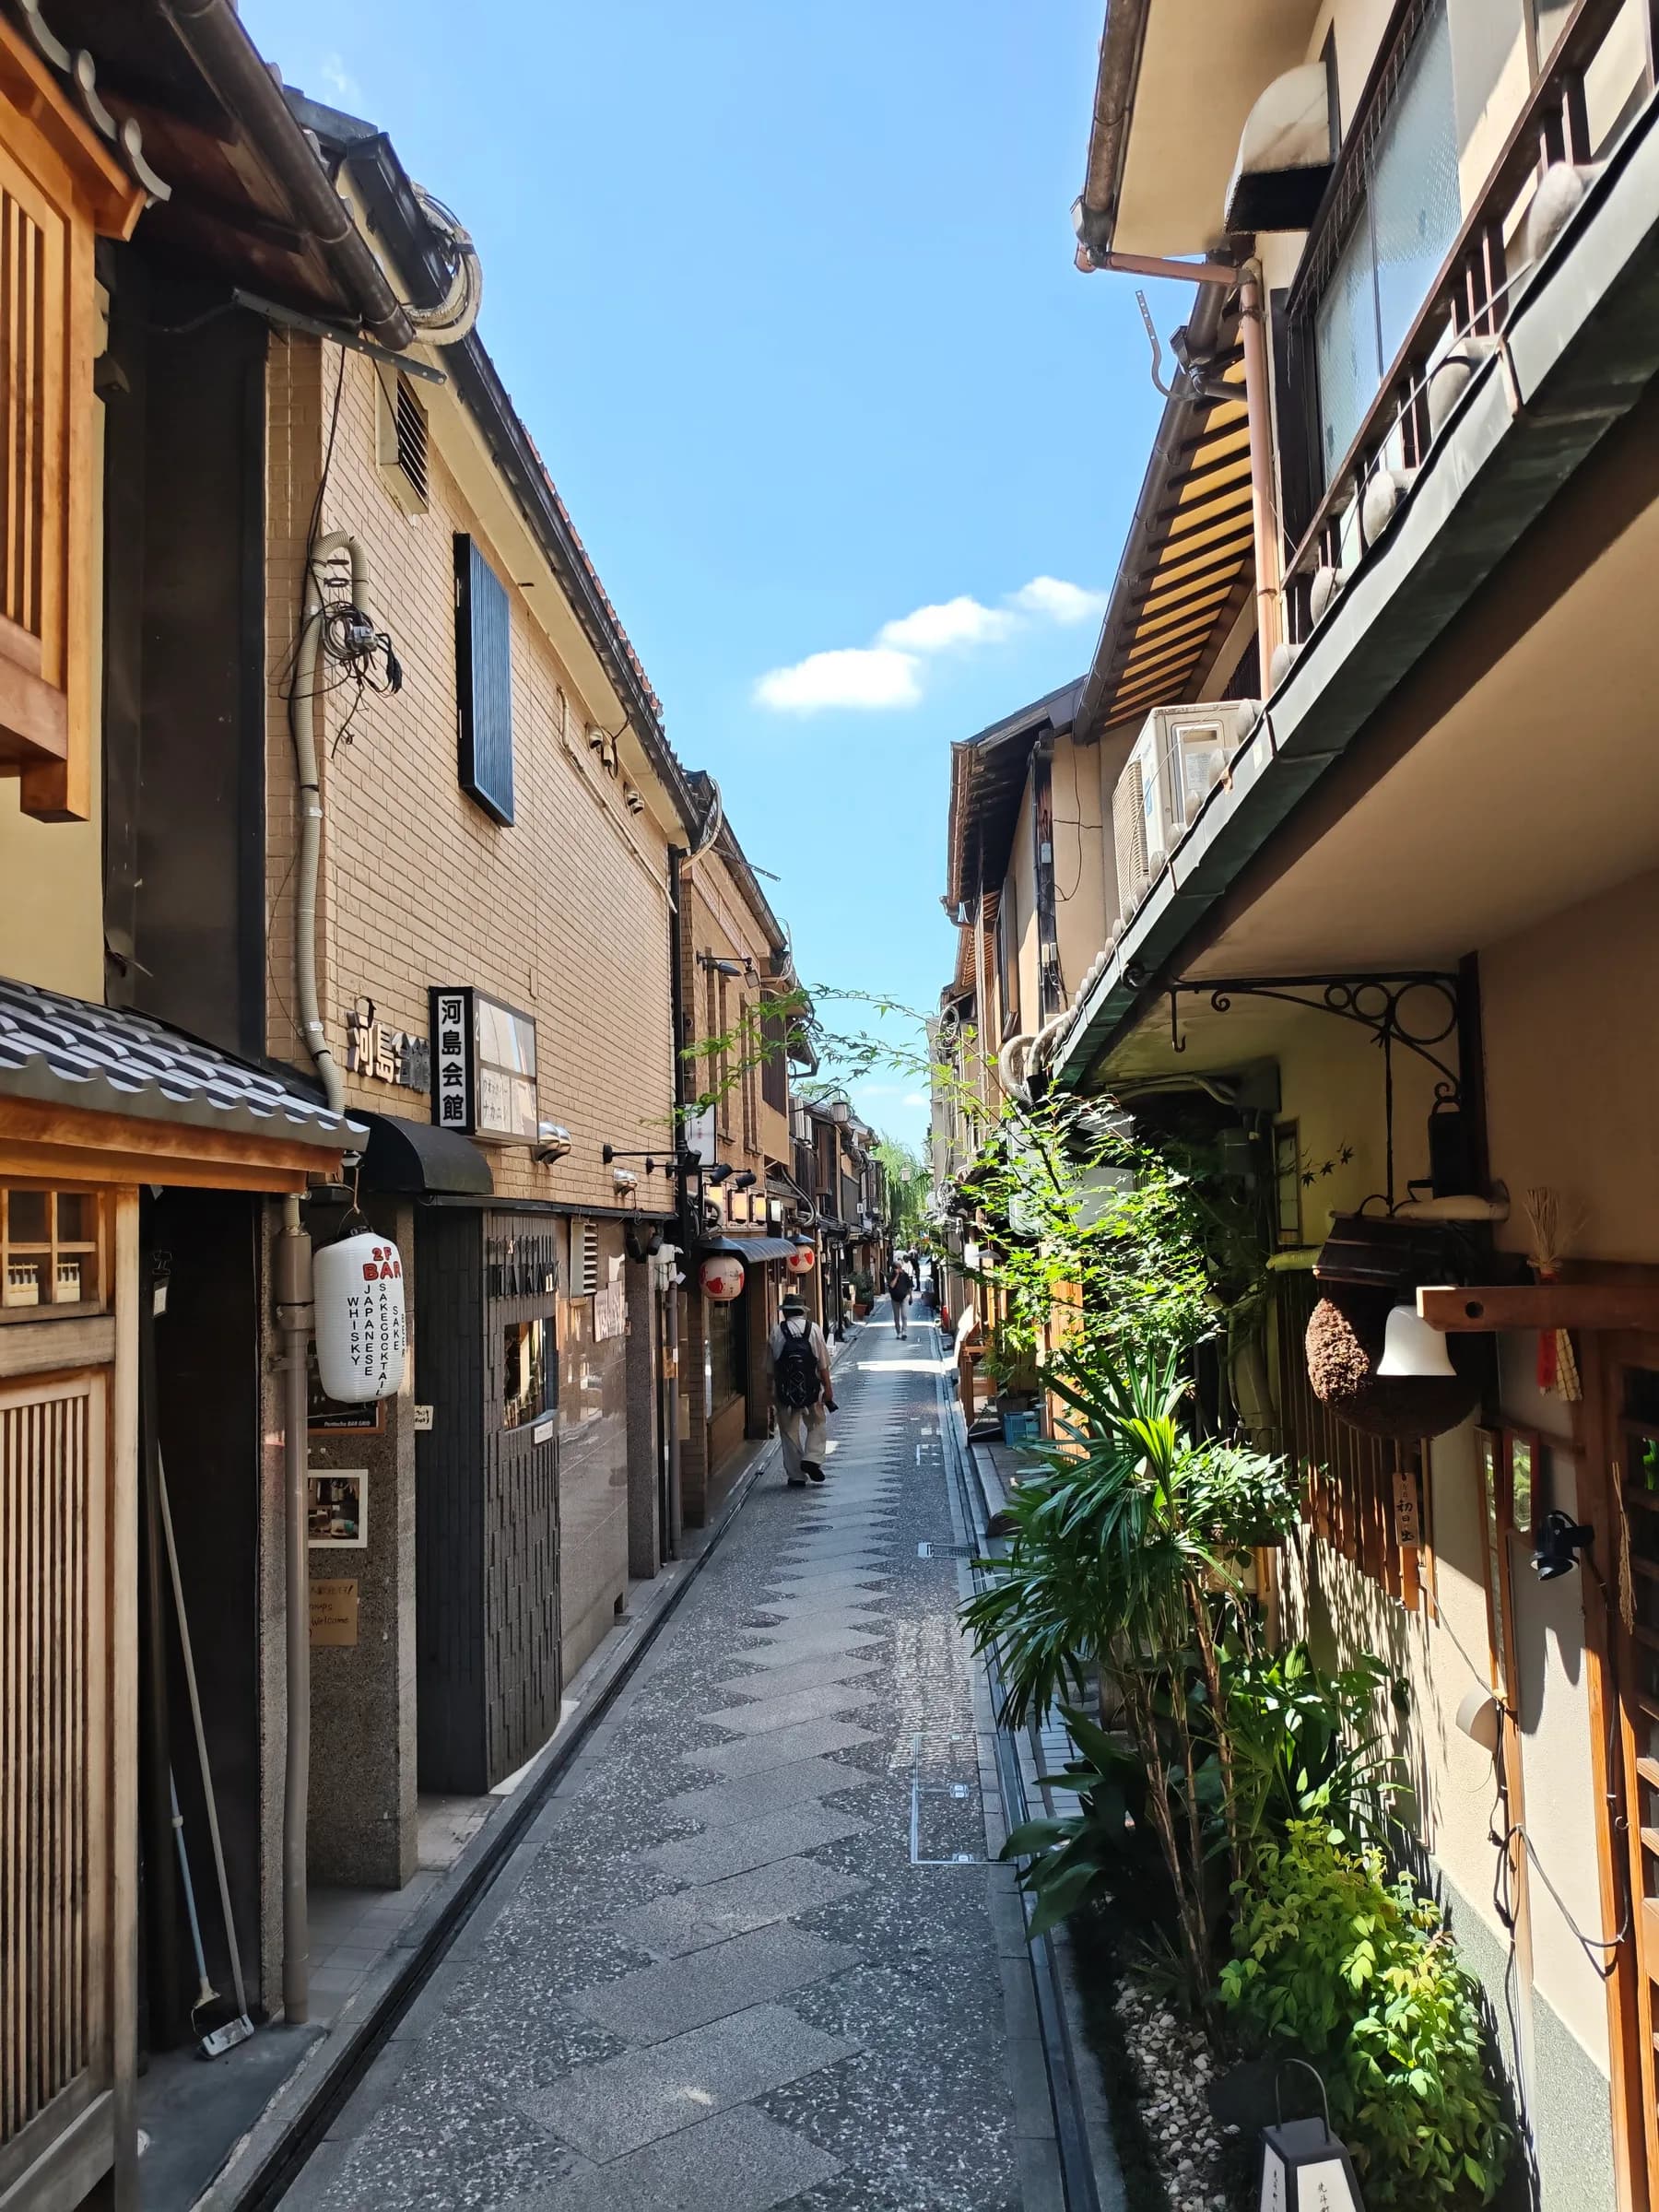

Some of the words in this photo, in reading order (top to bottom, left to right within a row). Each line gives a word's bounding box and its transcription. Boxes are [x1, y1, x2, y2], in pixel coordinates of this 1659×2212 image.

[441, 999, 464, 1121] 河島会館
[362, 1261, 401, 1281] BAR
[371, 1246, 392, 1261] 2F
[347, 1297, 360, 1365] WHISKY
[364, 1284, 374, 1376] JAPANESE
[375, 1283, 389, 1396] SAKECOCKTAIL
